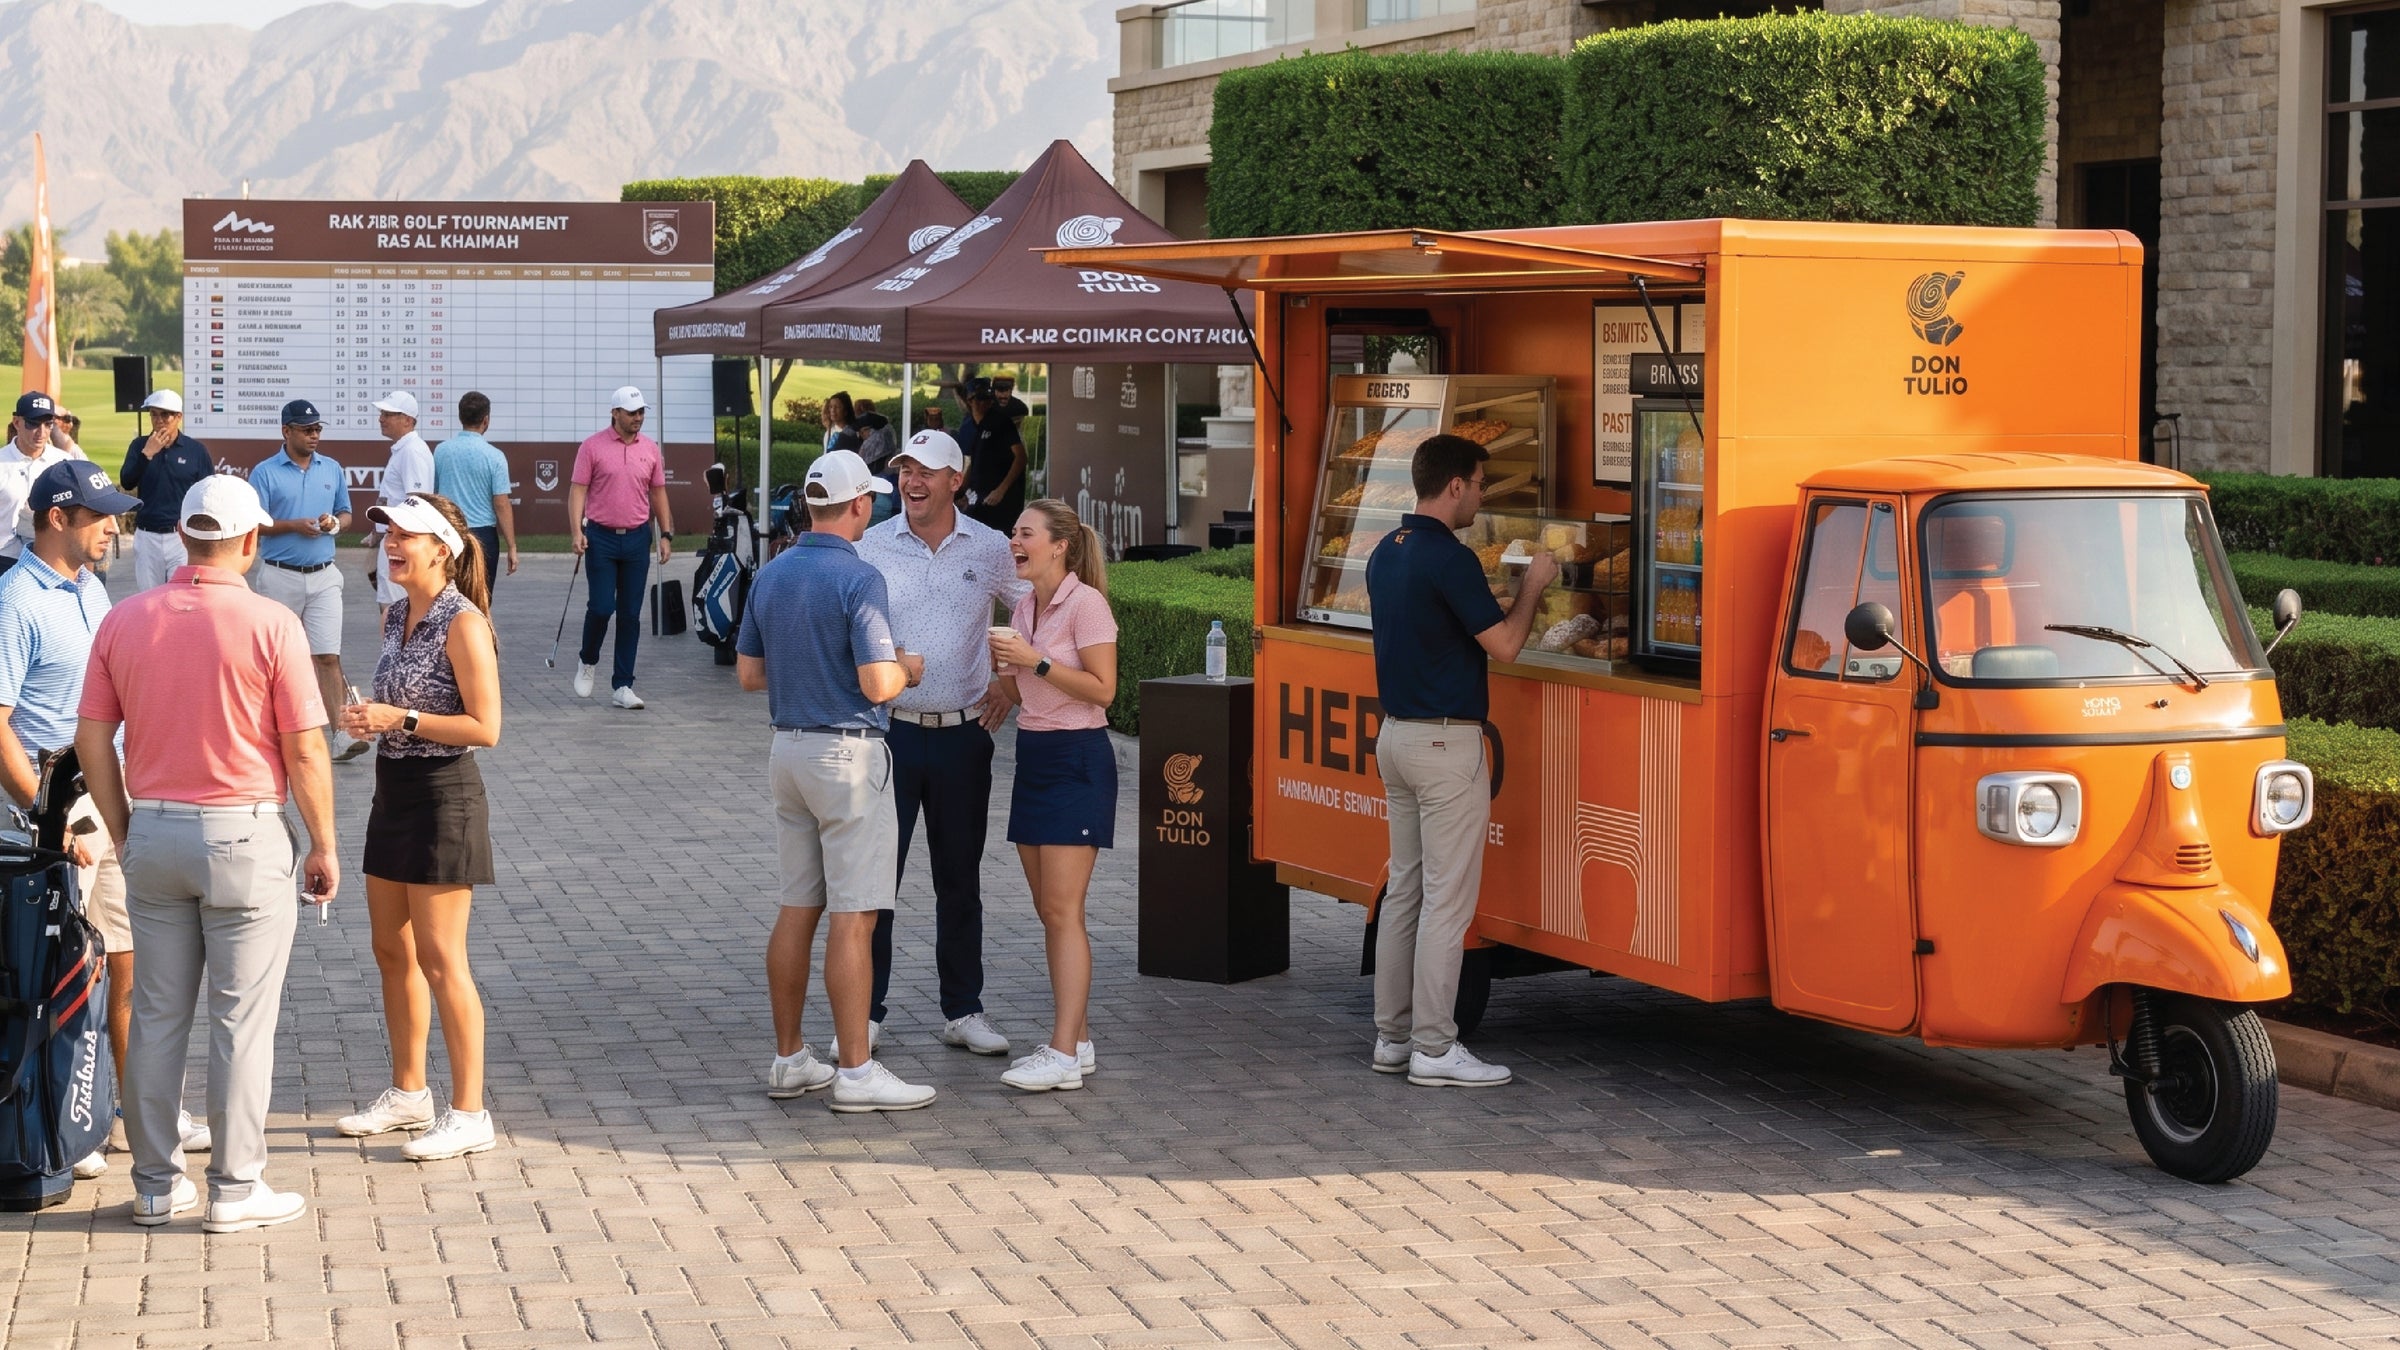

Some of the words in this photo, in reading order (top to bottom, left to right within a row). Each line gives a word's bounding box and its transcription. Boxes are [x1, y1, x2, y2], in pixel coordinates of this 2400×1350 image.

[329, 214, 364, 229] RAK
[404, 215, 448, 230] GOLF
[452, 215, 569, 231] TOURNAMENT
[377, 233, 411, 249] RAS
[414, 234, 437, 249] AL
[441, 234, 519, 249] KHAIMAH
[1078, 271, 1147, 283] DON
[1077, 283, 1161, 294] TULIO
[1911, 356, 1960, 374] DON
[1904, 377, 1968, 395] TULIO
[1163, 809, 1203, 828] DON
[1156, 825, 1211, 846] TULIO
